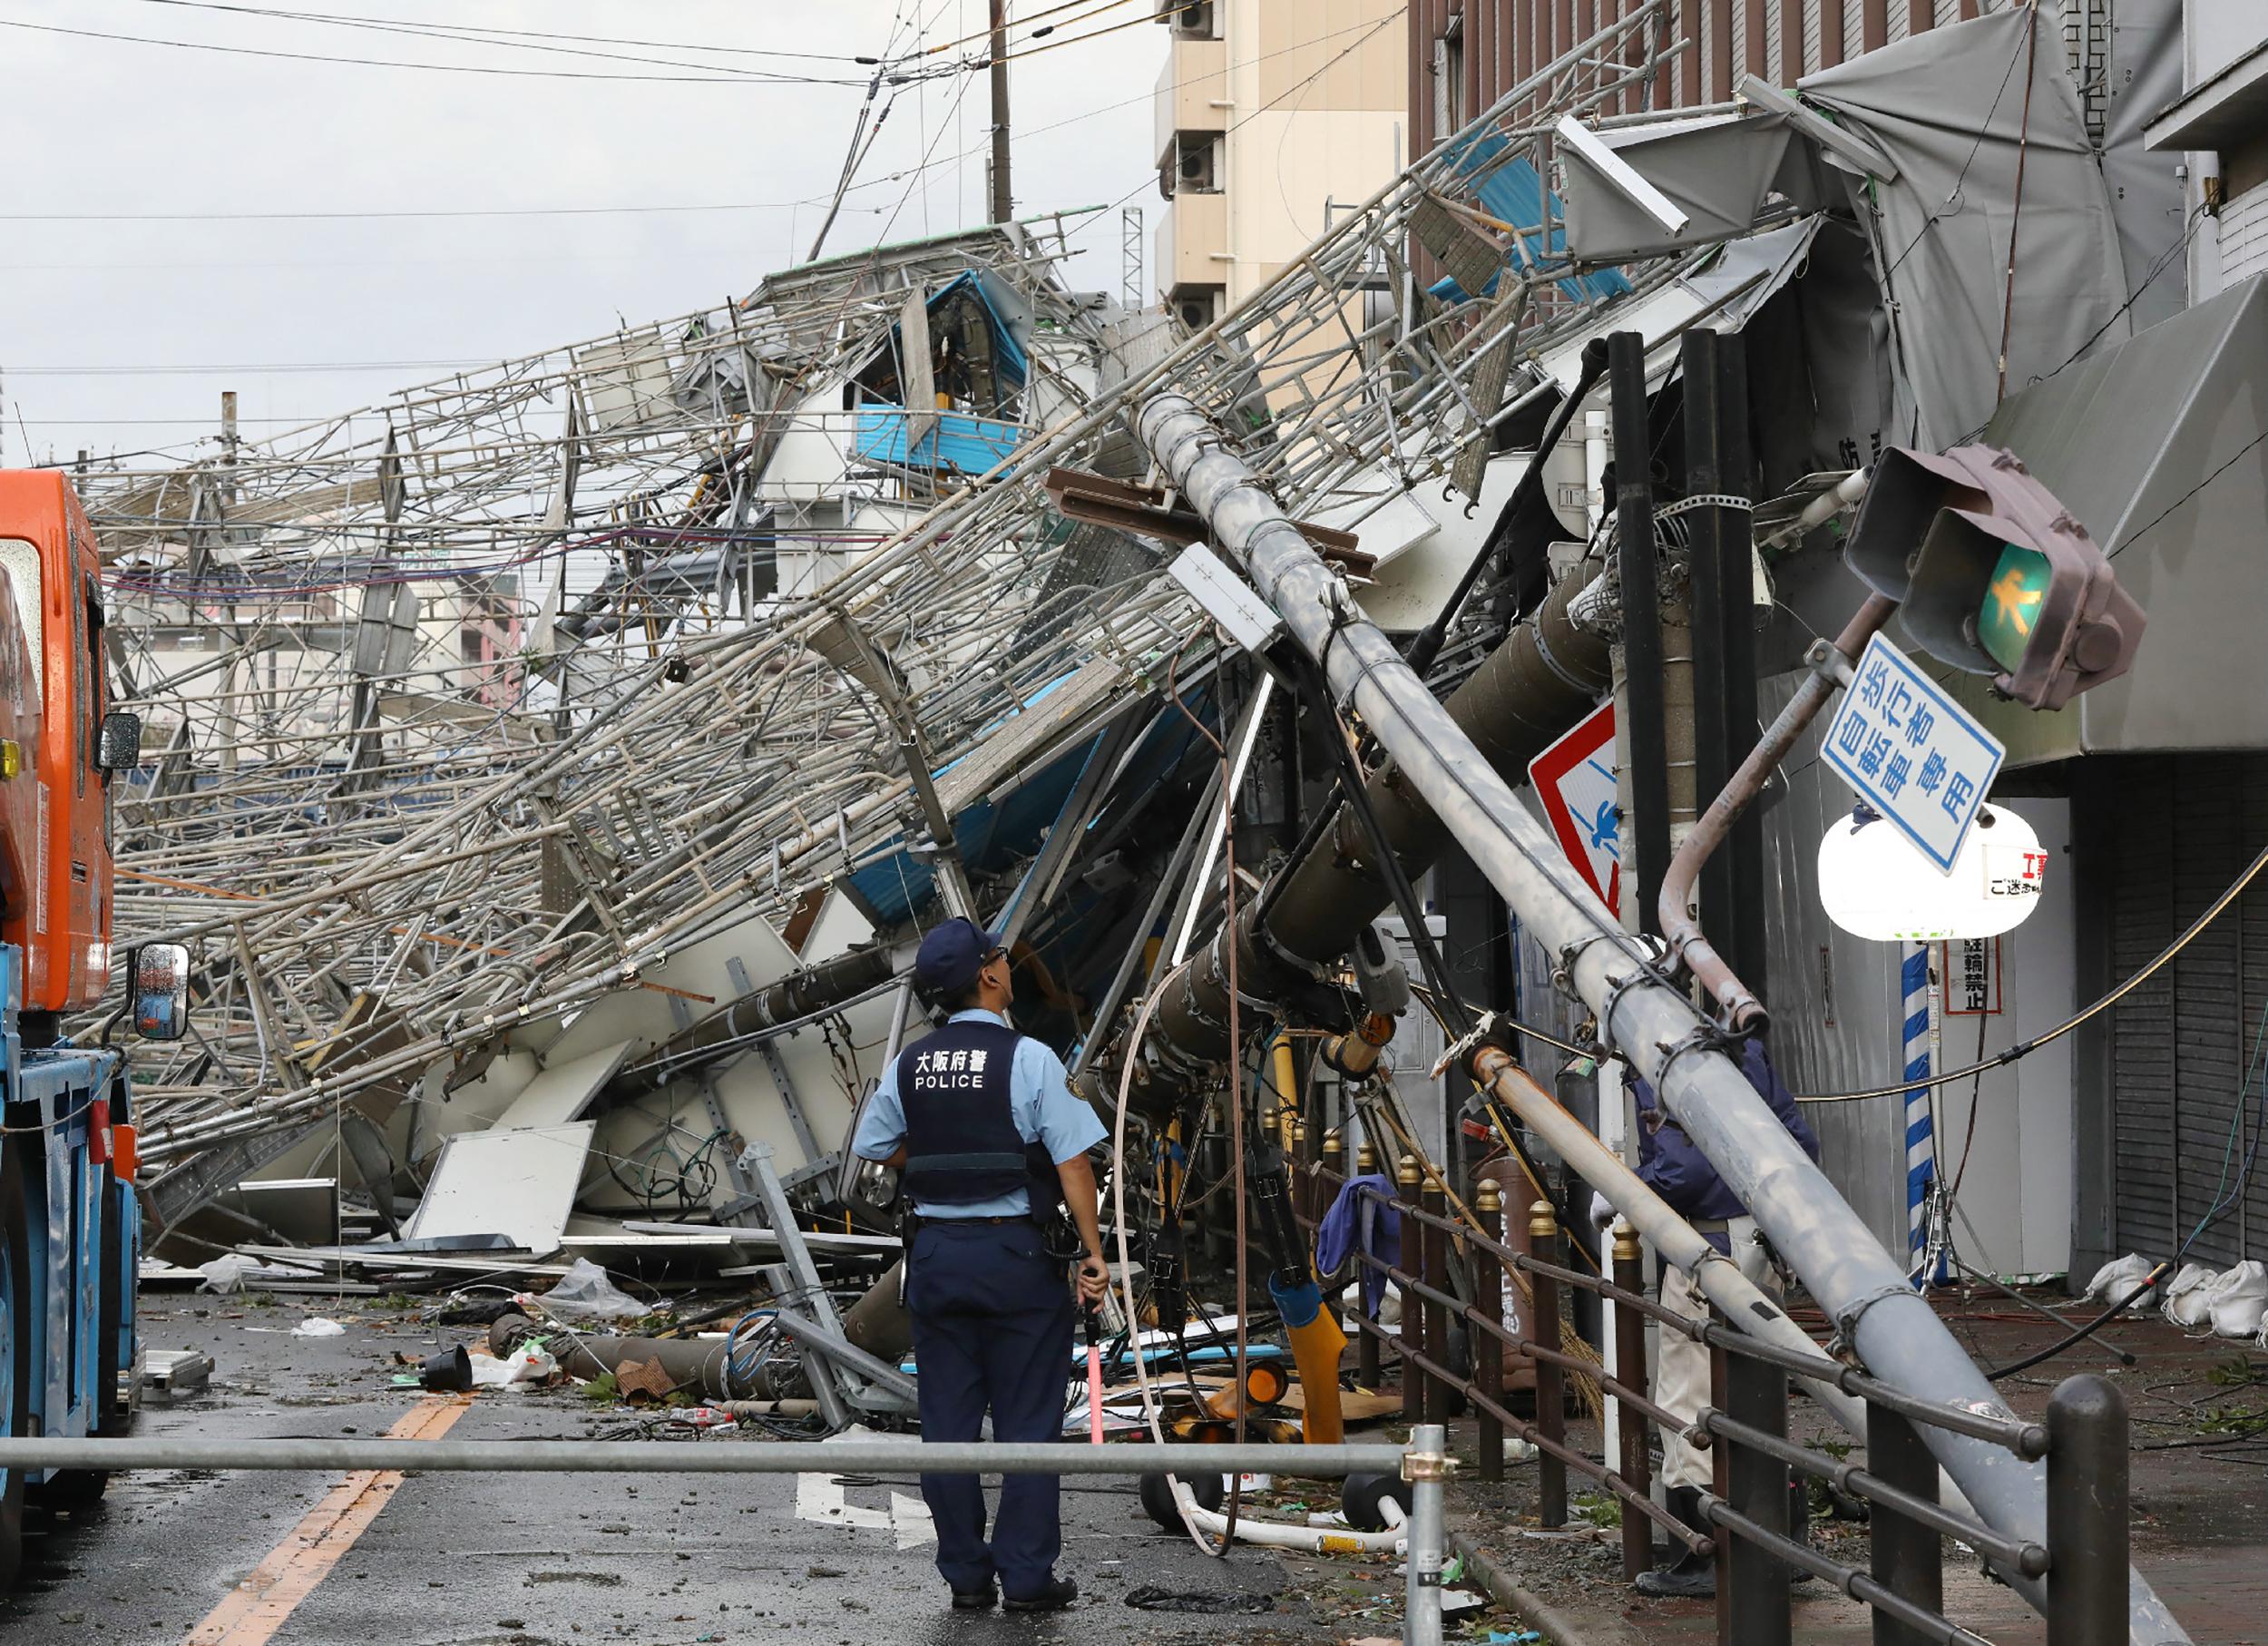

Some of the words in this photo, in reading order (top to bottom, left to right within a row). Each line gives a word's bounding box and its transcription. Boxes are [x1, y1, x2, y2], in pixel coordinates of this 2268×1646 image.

[1862, 661, 1934, 748] 歩行者
[1839, 710, 1912, 800] 自転車
[1916, 747, 1974, 825] 専用
[914, 1074, 983, 1090] POLICE
[915, 1050, 987, 1073] 大阪府警
